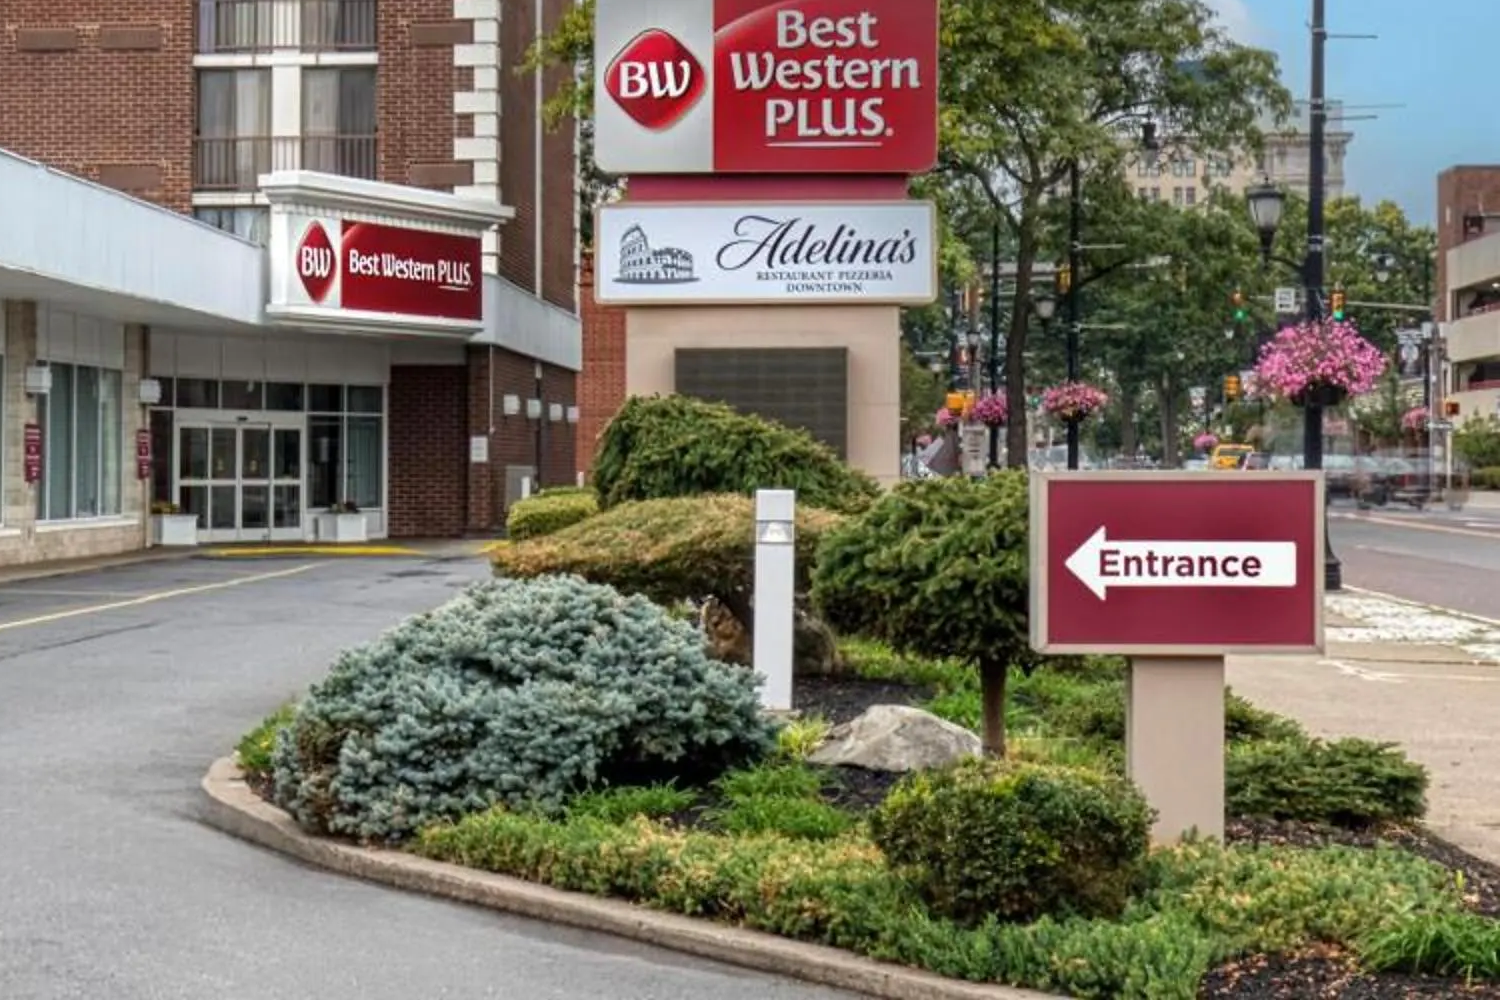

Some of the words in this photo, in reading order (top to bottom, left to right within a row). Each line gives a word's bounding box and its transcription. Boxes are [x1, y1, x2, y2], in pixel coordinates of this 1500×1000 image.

[776, 9, 879, 49] Best
[619, 60, 692, 100] BW
[730, 52, 921, 91] Western
[715, 214, 918, 271] Adelina's
[301, 246, 331, 279] BW
[349, 249, 381, 276] Best
[381, 252, 436, 284] Western
[756, 270, 834, 282] RESTAURANT
[838, 270, 893, 281] PIZZERIA
[786, 282, 864, 294] DOWNTOWN
[1098, 549, 1263, 578] Entrance
